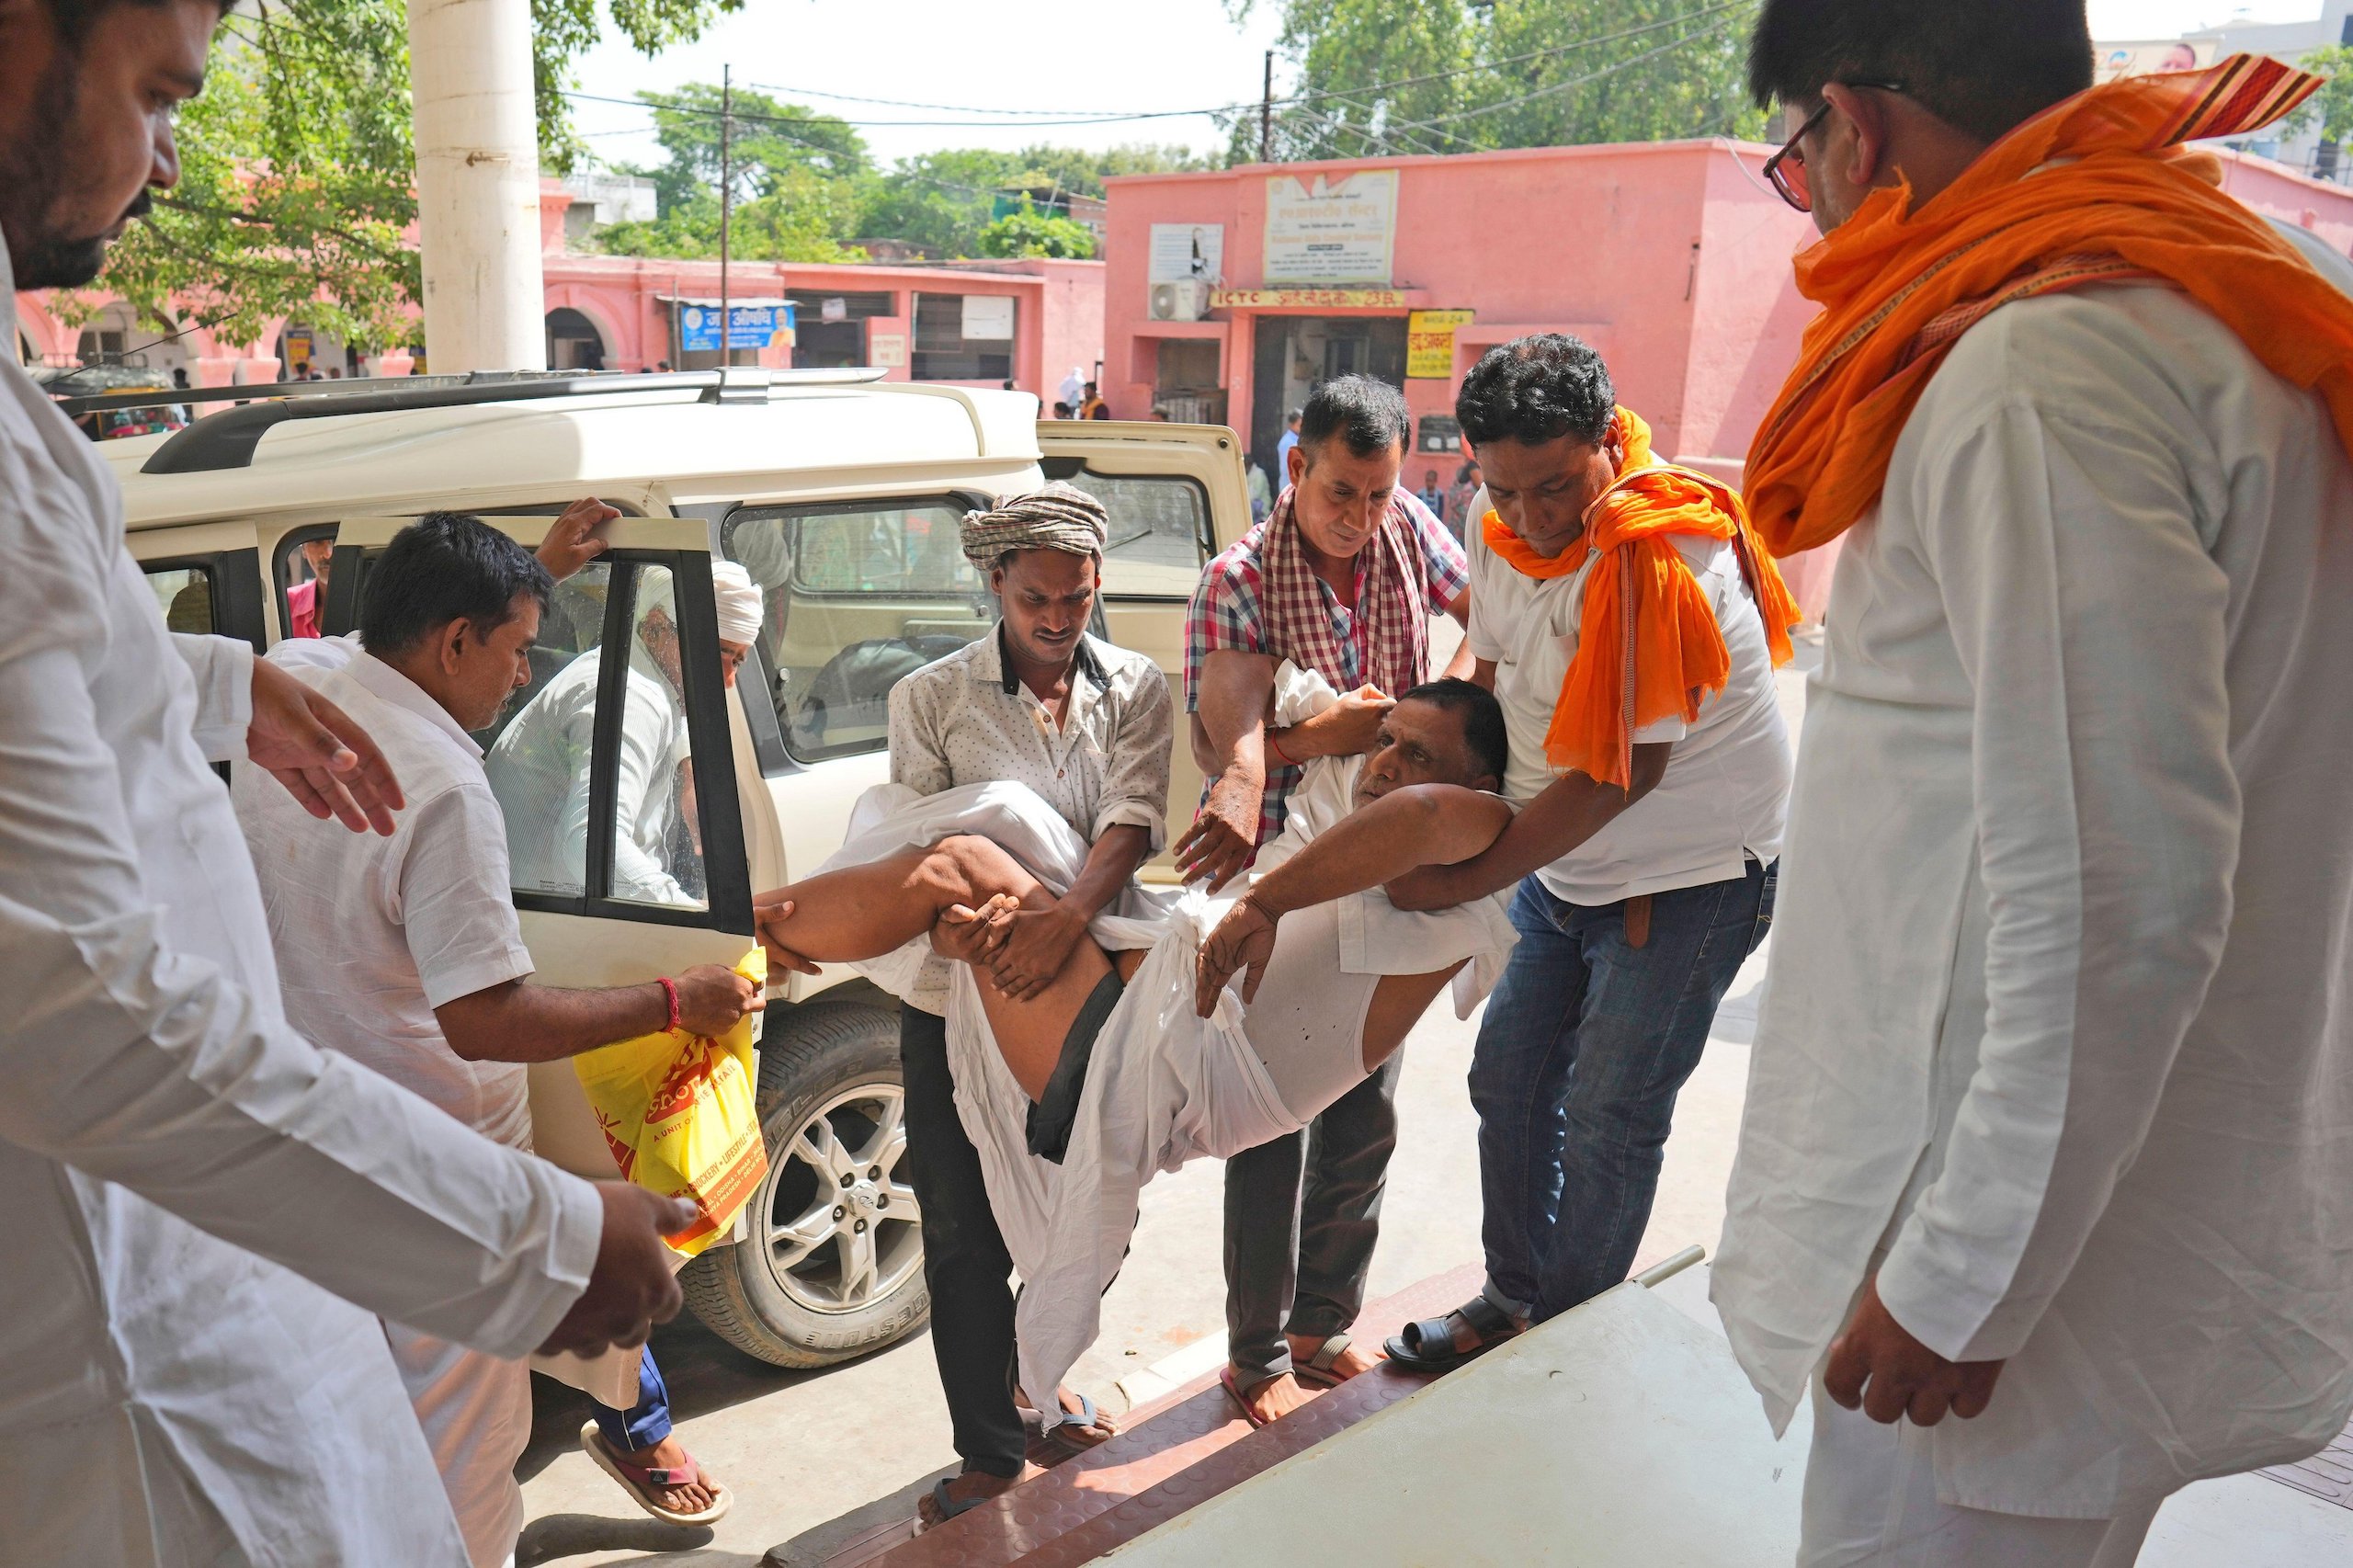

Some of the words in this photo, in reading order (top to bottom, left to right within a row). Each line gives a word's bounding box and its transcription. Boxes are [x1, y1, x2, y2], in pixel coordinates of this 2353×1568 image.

[1218, 291, 1259, 304] ICTC
[661, 1124, 682, 1138] UNIT
[688, 1162, 720, 1192] CROCKERY
[722, 1133, 747, 1165] LIFESTYLE
[717, 1176, 735, 1196] ODISHA
[720, 1181, 742, 1204] PRADESH
[805, 1288, 930, 1349] GESTONE
